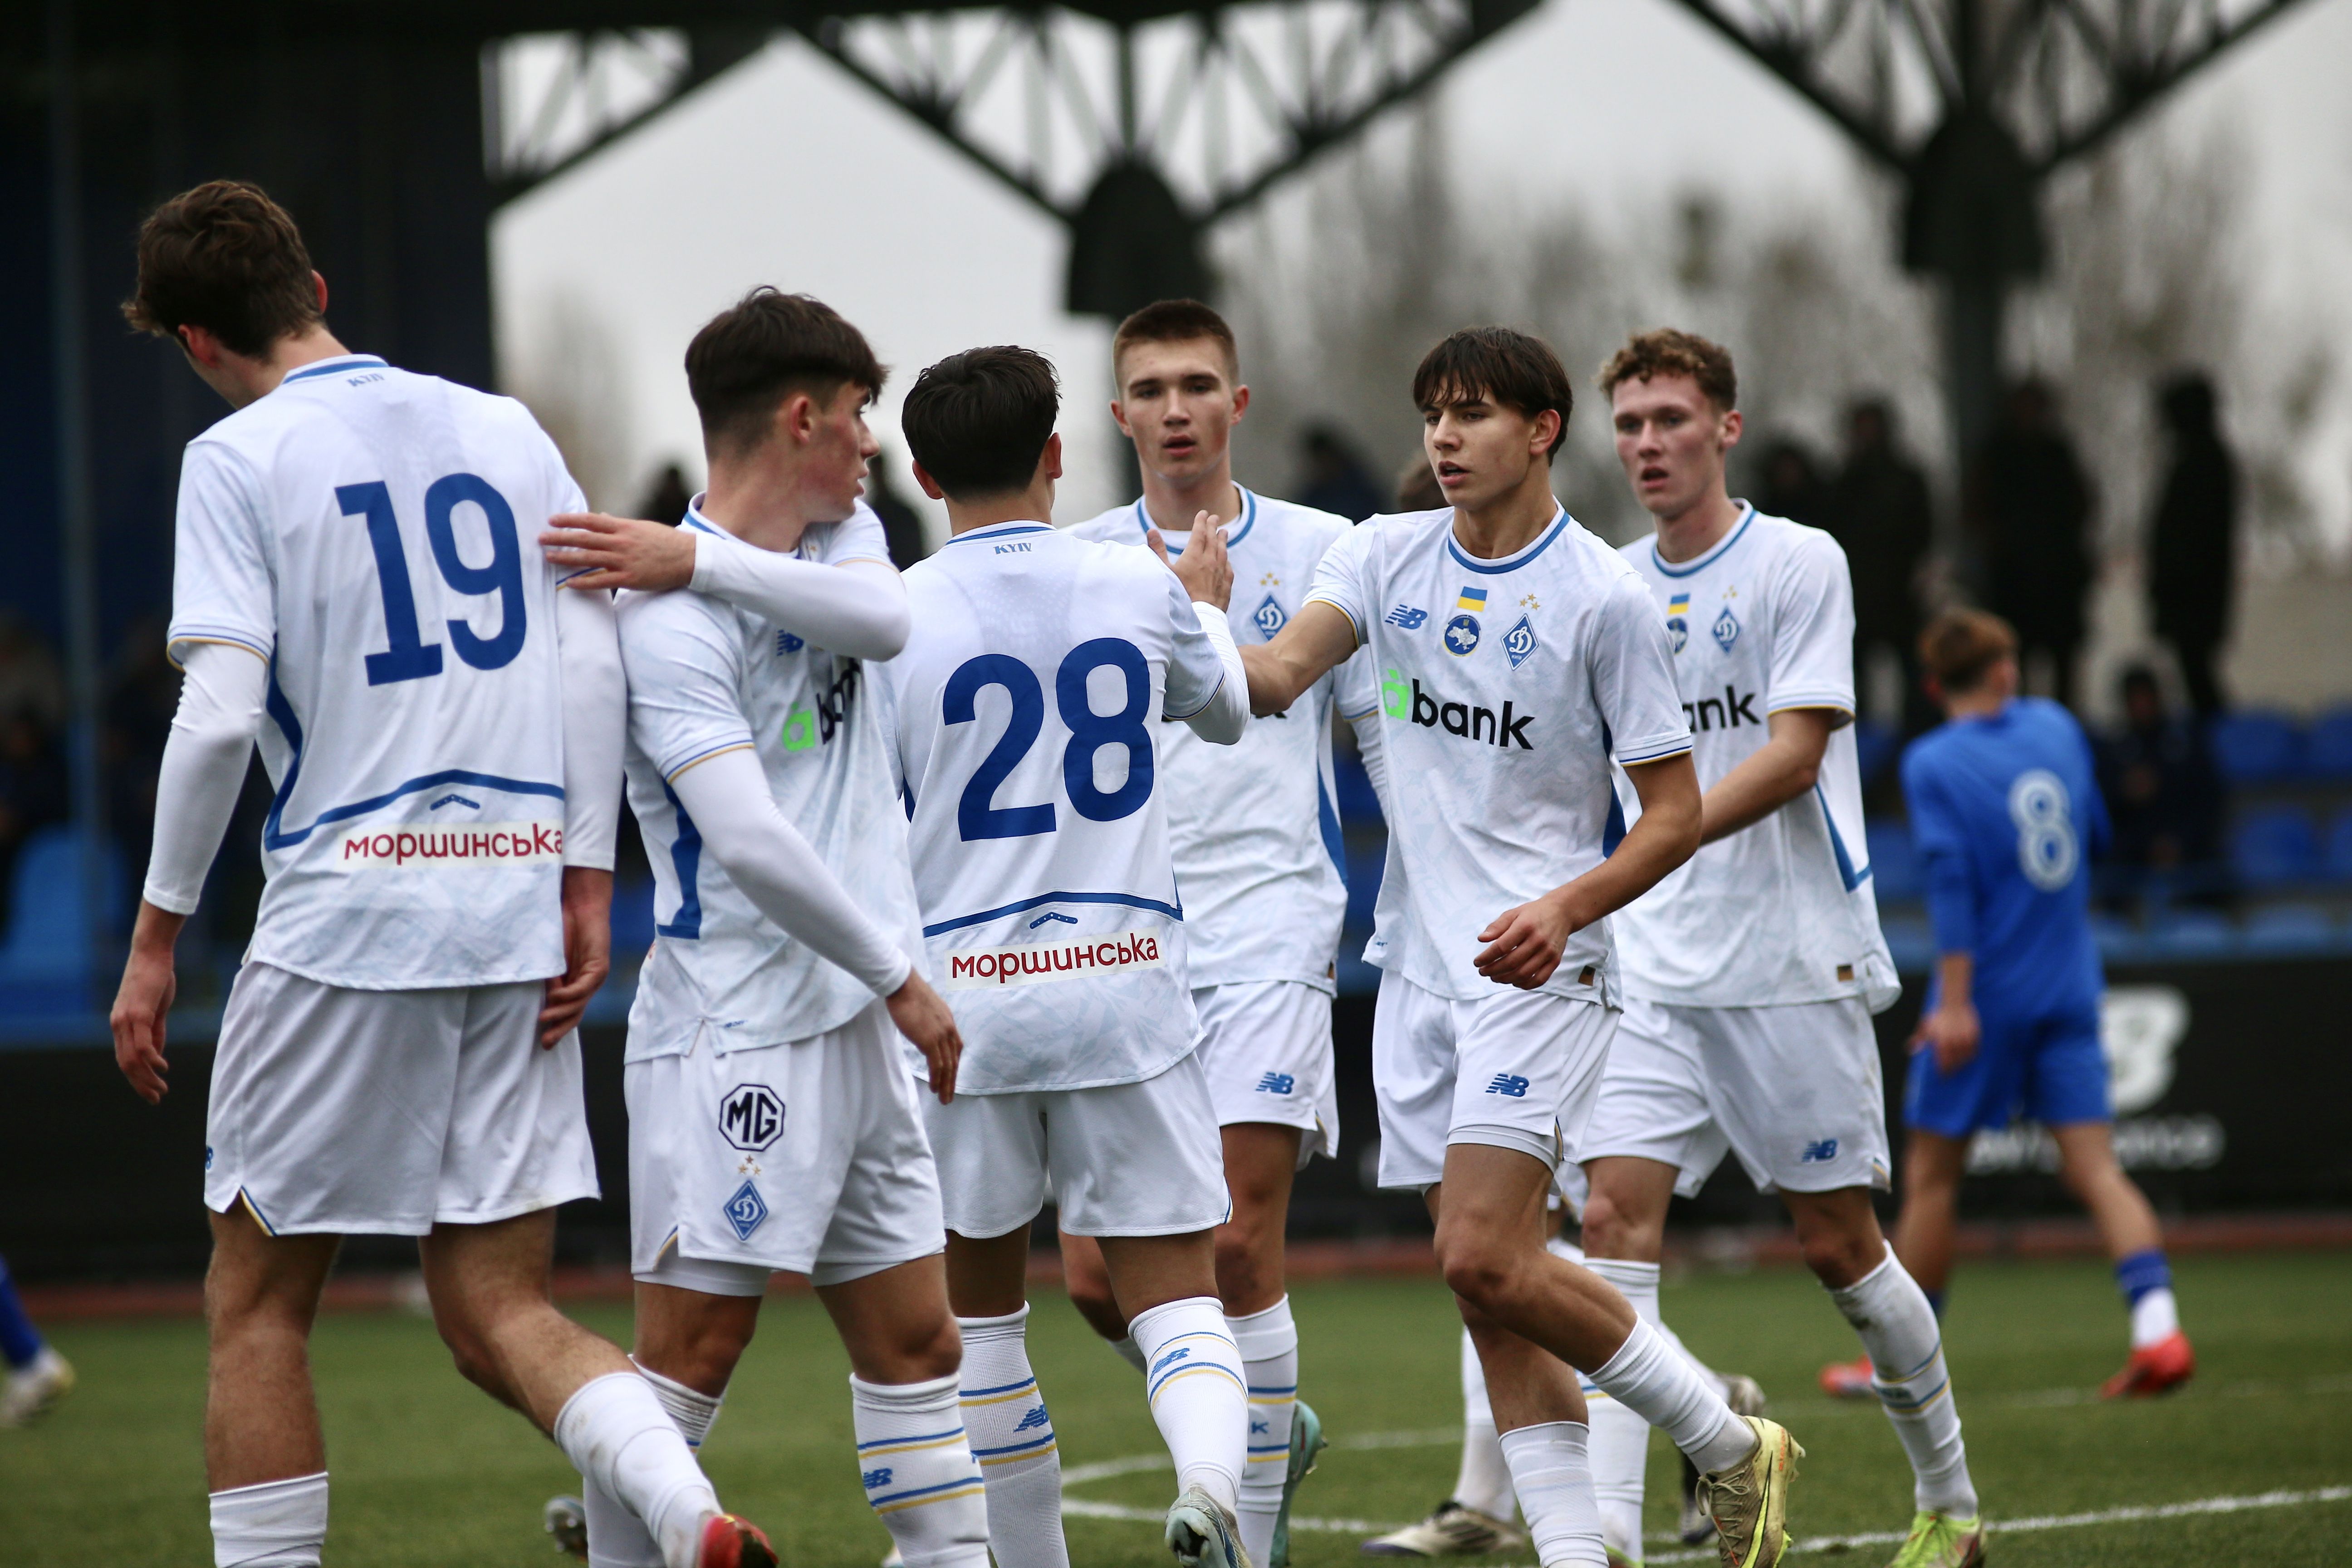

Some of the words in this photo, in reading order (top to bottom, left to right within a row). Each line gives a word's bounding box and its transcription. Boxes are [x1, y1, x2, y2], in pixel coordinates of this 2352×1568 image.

[334, 473, 526, 686] 19
[993, 542, 1032, 554] KYIV
[943, 637, 1155, 843] 28
[2007, 768, 2079, 892] 8
[952, 933, 1159, 984] моршинська
[727, 1092, 777, 1143] MG
